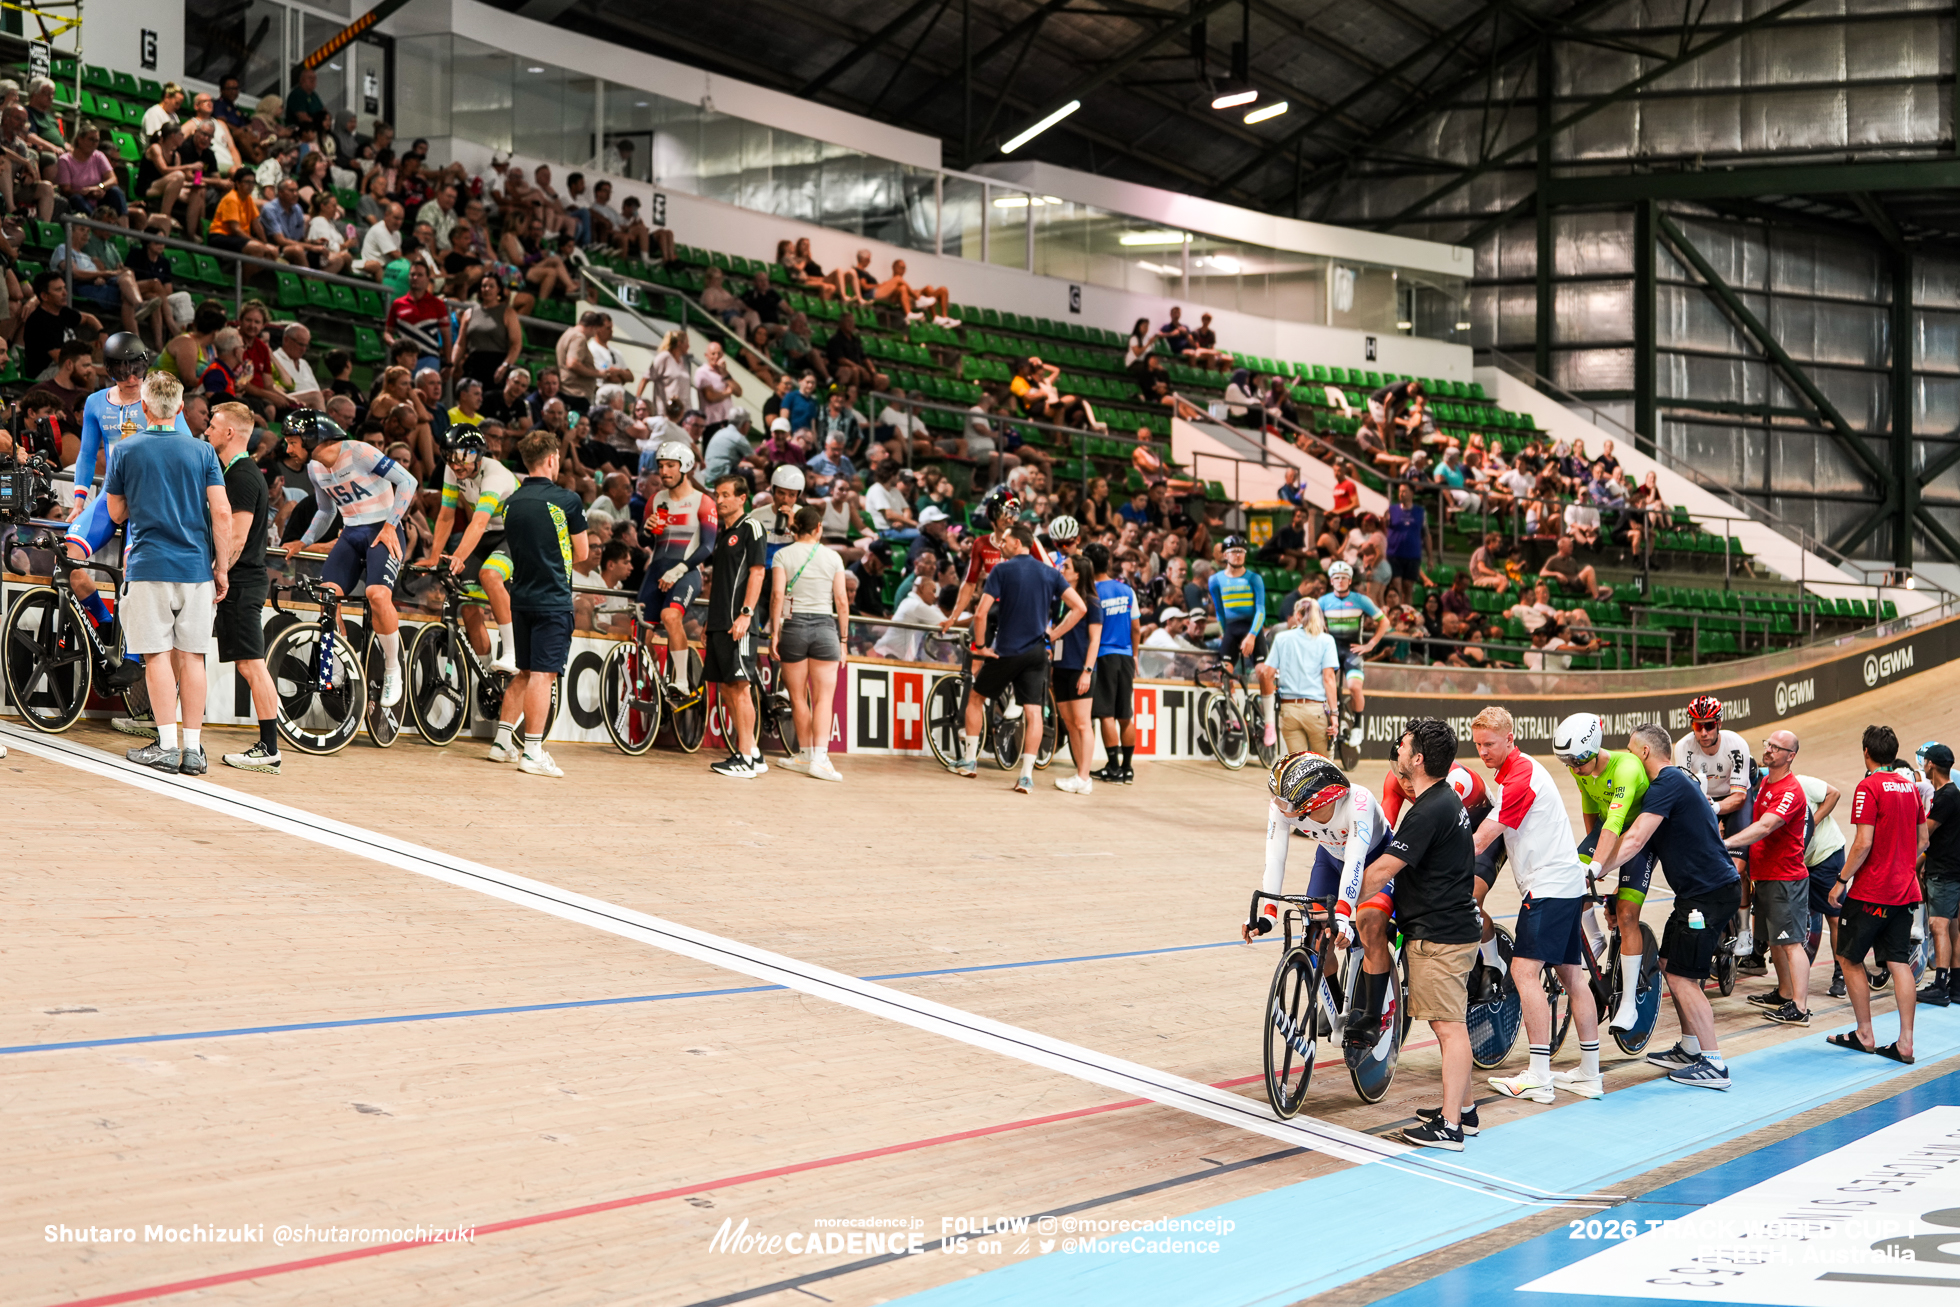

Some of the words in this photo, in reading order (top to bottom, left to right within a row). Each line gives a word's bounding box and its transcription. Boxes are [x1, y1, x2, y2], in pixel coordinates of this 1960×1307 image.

[1366, 338, 1376, 357] H
[71, 594, 106, 655] PINARELLO
[457, 628, 488, 678] PINARELLO
[1879, 645, 1914, 678] GWM
[1788, 677, 1815, 708] GWM
[1580, 718, 1597, 745] RUDY
[1731, 749, 1744, 774] KTM
[1882, 781, 1915, 793] GERMANY
